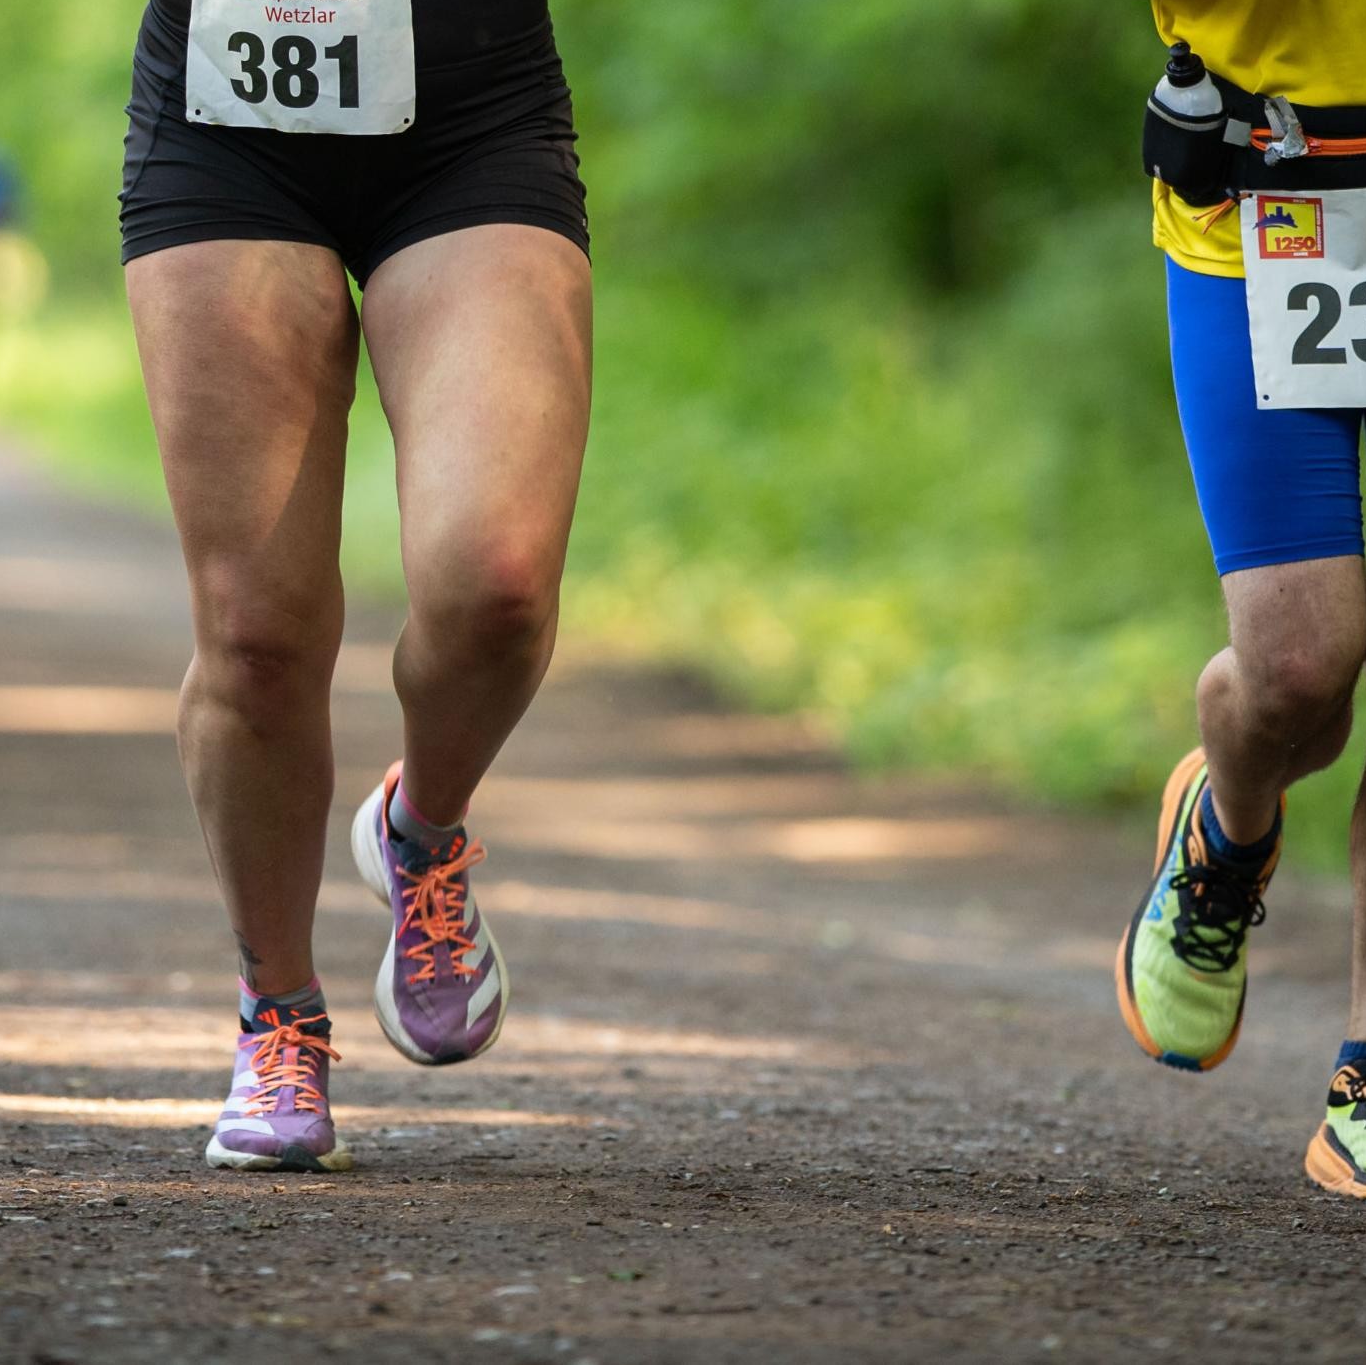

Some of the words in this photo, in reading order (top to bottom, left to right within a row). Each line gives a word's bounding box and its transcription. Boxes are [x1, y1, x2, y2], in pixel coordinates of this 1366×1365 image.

[265, 6, 337, 24] Wetzlar
[227, 31, 360, 109] 381
[1274, 236, 1316, 251] 1250
